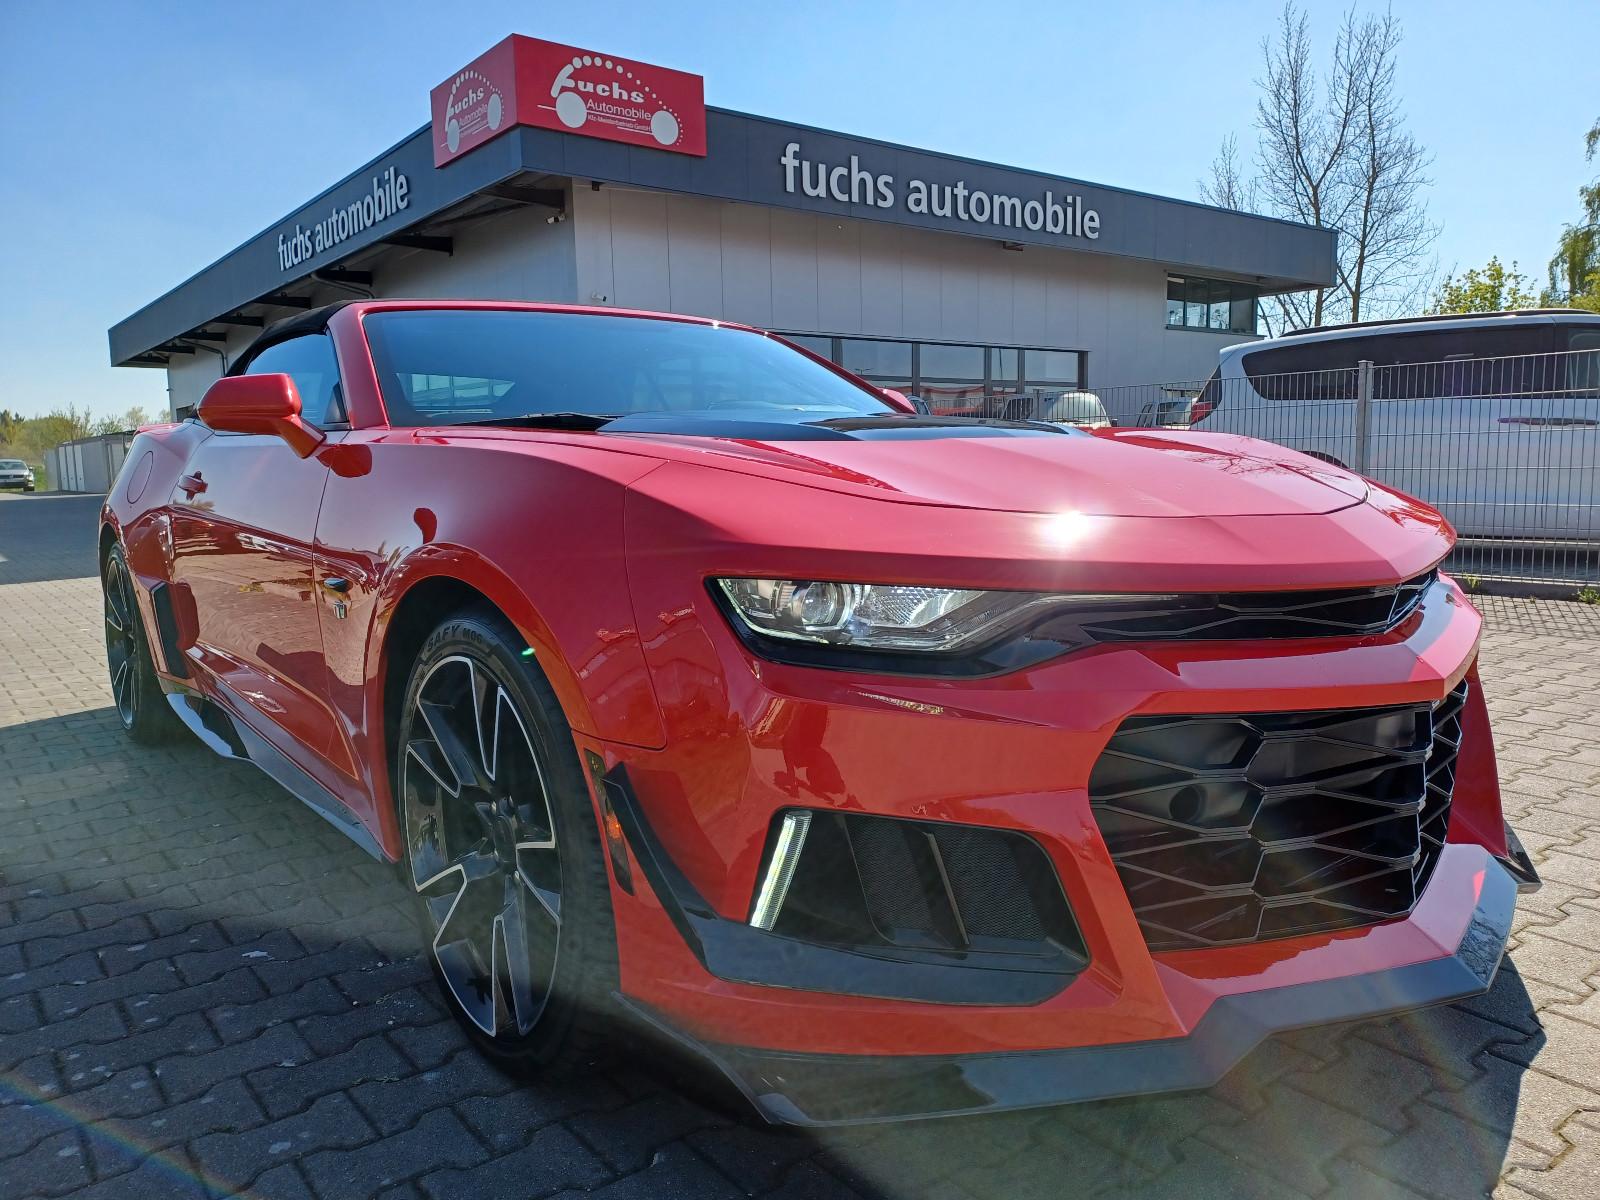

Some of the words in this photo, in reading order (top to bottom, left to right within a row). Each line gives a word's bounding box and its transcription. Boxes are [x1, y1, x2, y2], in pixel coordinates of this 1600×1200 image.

[551, 64, 645, 103] fuchs
[586, 98, 652, 120] Automobile
[278, 224, 313, 271] fuchs
[315, 166, 408, 253] automobile
[781, 142, 894, 208] fuchs
[907, 179, 1100, 239] automobile
